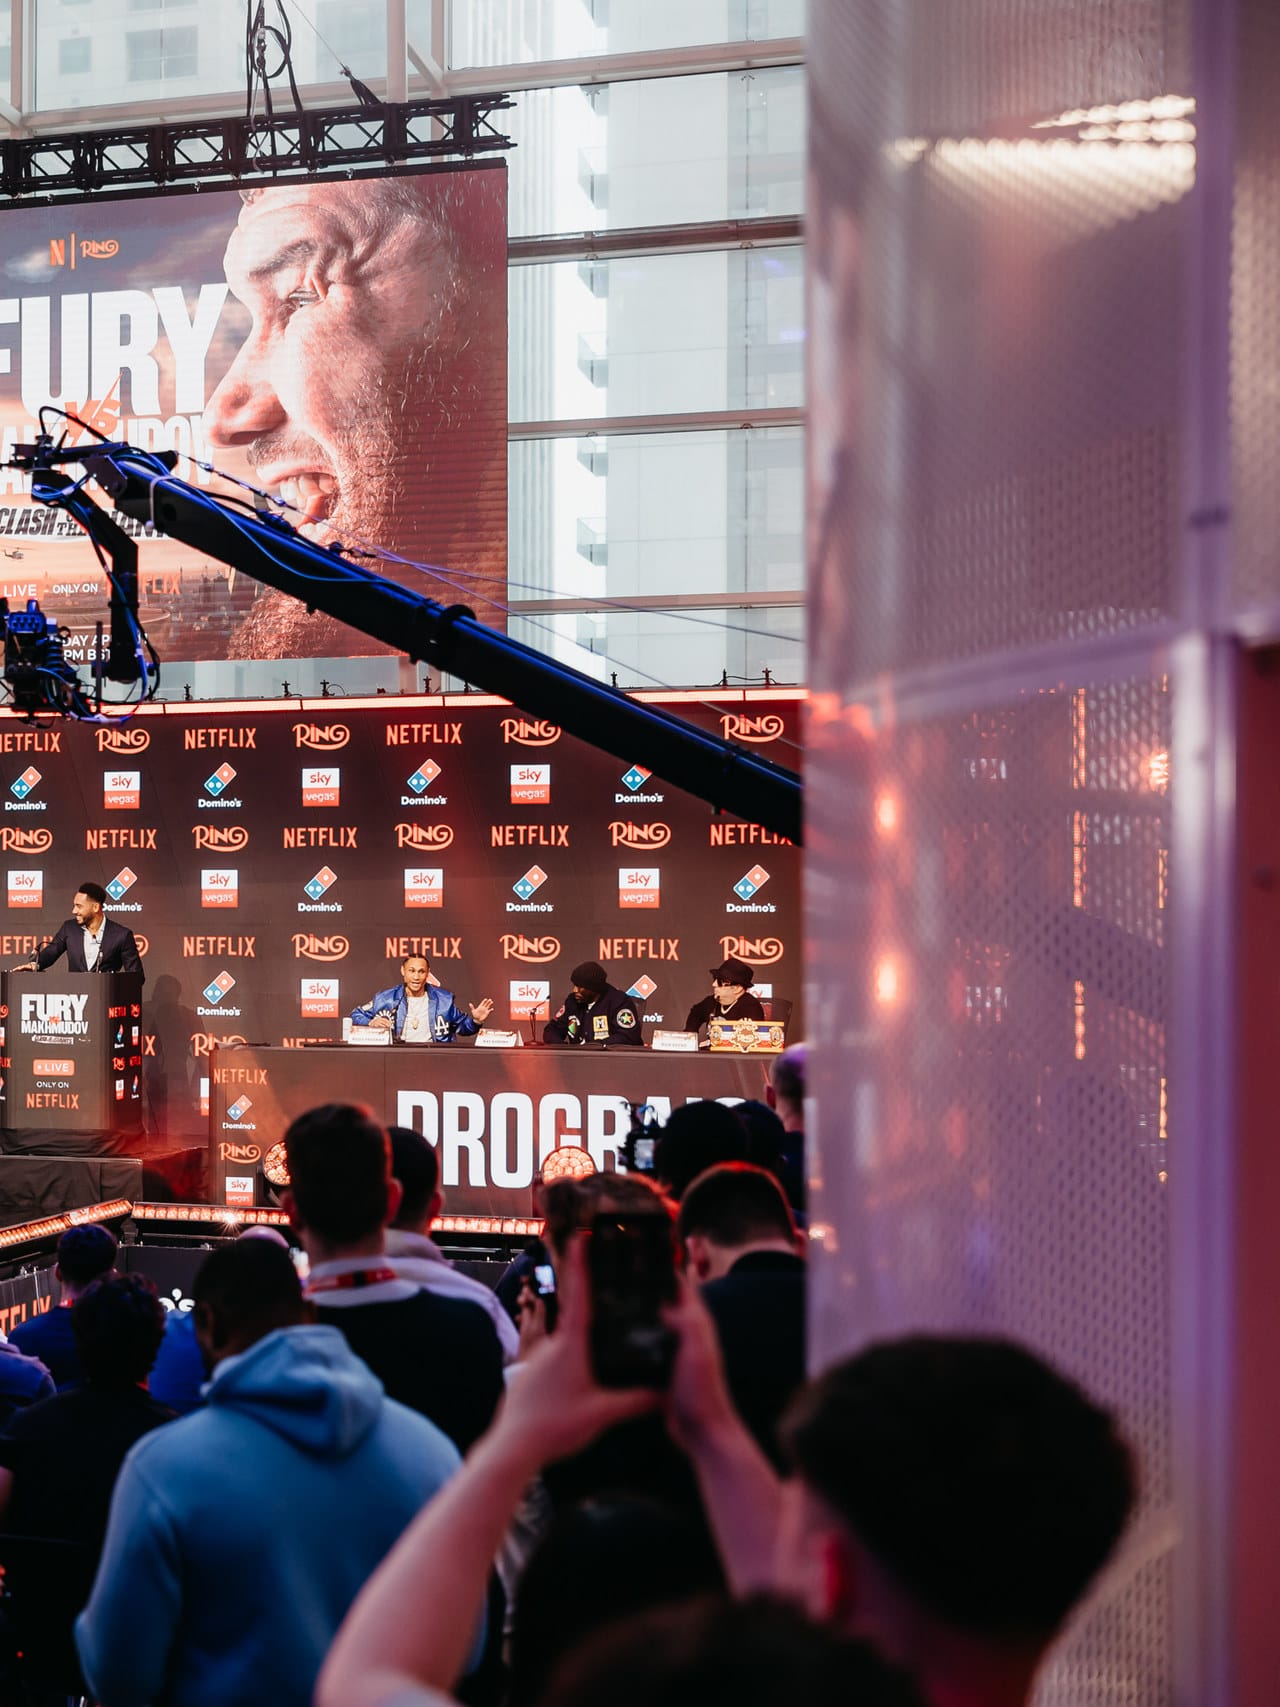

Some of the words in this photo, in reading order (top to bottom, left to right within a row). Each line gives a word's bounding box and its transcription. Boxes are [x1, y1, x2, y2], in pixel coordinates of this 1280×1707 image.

[49, 239, 65, 267] N
[3, 584, 38, 598] LIVE
[52, 584, 80, 595] ONLY
[82, 583, 98, 593] ON
[386, 722, 463, 746] NETFLIX
[719, 713, 785, 743] RING
[94, 727, 151, 755] RING
[184, 727, 257, 750] NETFLIX
[291, 723, 351, 751] RING
[111, 776, 132, 789] sky
[309, 772, 331, 786] sky
[518, 769, 542, 783] sky
[107, 795, 136, 805] vegas
[305, 793, 335, 803] vegas
[400, 794, 448, 806] Domino's
[513, 789, 546, 800] vegas
[615, 792, 665, 803] Domino's
[4, 800, 47, 811] Domino's
[197, 797, 243, 808] Domino's
[86, 828, 157, 851] NETFLIX
[191, 824, 249, 853] RING
[283, 826, 358, 849] NETFLIX
[394, 822, 455, 851] RING
[491, 824, 569, 848] NETFLIX
[607, 821, 672, 850] RING
[15, 875, 36, 888] sky
[209, 873, 230, 887] sky
[412, 873, 435, 887] sky
[627, 872, 651, 887] sky
[10, 894, 38, 904] vegas
[204, 894, 233, 904] vegas
[407, 893, 438, 903] vegas
[622, 893, 655, 904] vegas
[297, 901, 343, 912] Domino's
[505, 901, 554, 913] Domino's
[726, 902, 777, 913] Domino's
[183, 936, 256, 958] NETFLIX
[291, 933, 350, 962] RING
[385, 937, 462, 959] NETFLIX
[498, 934, 561, 963] RING
[599, 938, 679, 961] NETFLIX
[719, 935, 784, 965] RING
[309, 983, 331, 997] sky
[518, 985, 541, 1000] sky
[21, 994, 88, 1021] FURY
[196, 1005, 242, 1017] Domino's
[304, 1004, 334, 1014] vegas
[21, 1020, 88, 1035] MAKHMUDOV
[44, 1063, 69, 1072] LIVE
[213, 1068, 268, 1085] NETFLIX
[36, 1081, 56, 1089] ONLY
[58, 1081, 69, 1089] ON
[26, 1092, 80, 1110] NETFLIX
